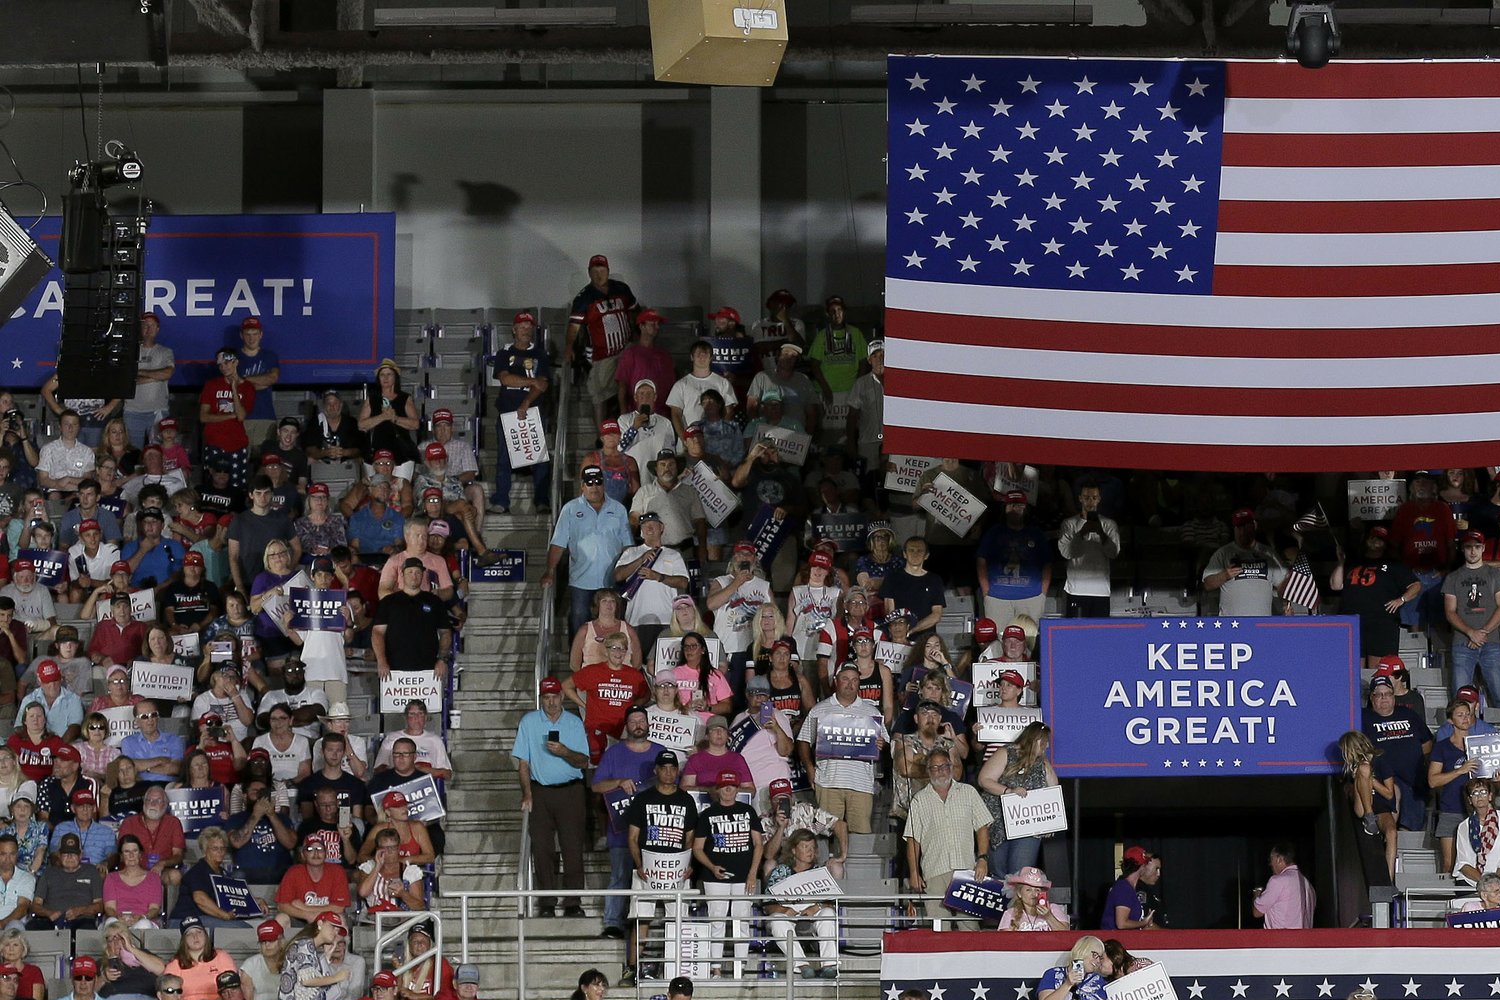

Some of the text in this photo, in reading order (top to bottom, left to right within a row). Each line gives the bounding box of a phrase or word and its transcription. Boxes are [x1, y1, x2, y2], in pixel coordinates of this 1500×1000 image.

[145, 278, 313, 317] REAT!
[509, 428, 521, 453] KEEP
[529, 418, 542, 453] GREAT!
[202, 492, 231, 506] Trump
[947, 486, 969, 506] KEEP
[930, 488, 972, 523] AMERICA
[931, 500, 960, 524] GREAT!
[1351, 566, 1376, 585] 45
[294, 600, 341, 609] TRUMP
[1147, 642, 1254, 670] KEEP
[137, 671, 187, 685] Women
[398, 677, 424, 685] KEEP
[385, 686, 438, 696] AMERICA
[598, 688, 633, 699] TRUMP
[1104, 680, 1297, 707] AMERICA
[651, 715, 678, 725] KEEP
[823, 727, 877, 736] TRUMP
[1126, 715, 1276, 745] GREAT!
[827, 735, 871, 743] PENCE
[169, 800, 220, 811] TRUMP
[669, 804, 685, 815] YEA
[1008, 801, 1059, 818] Women
[654, 815, 685, 827] VOTED
[1016, 814, 1056, 826] FOR TRUMP
[655, 859, 681, 868] KEEP
[217, 885, 248, 895] TRUMP
